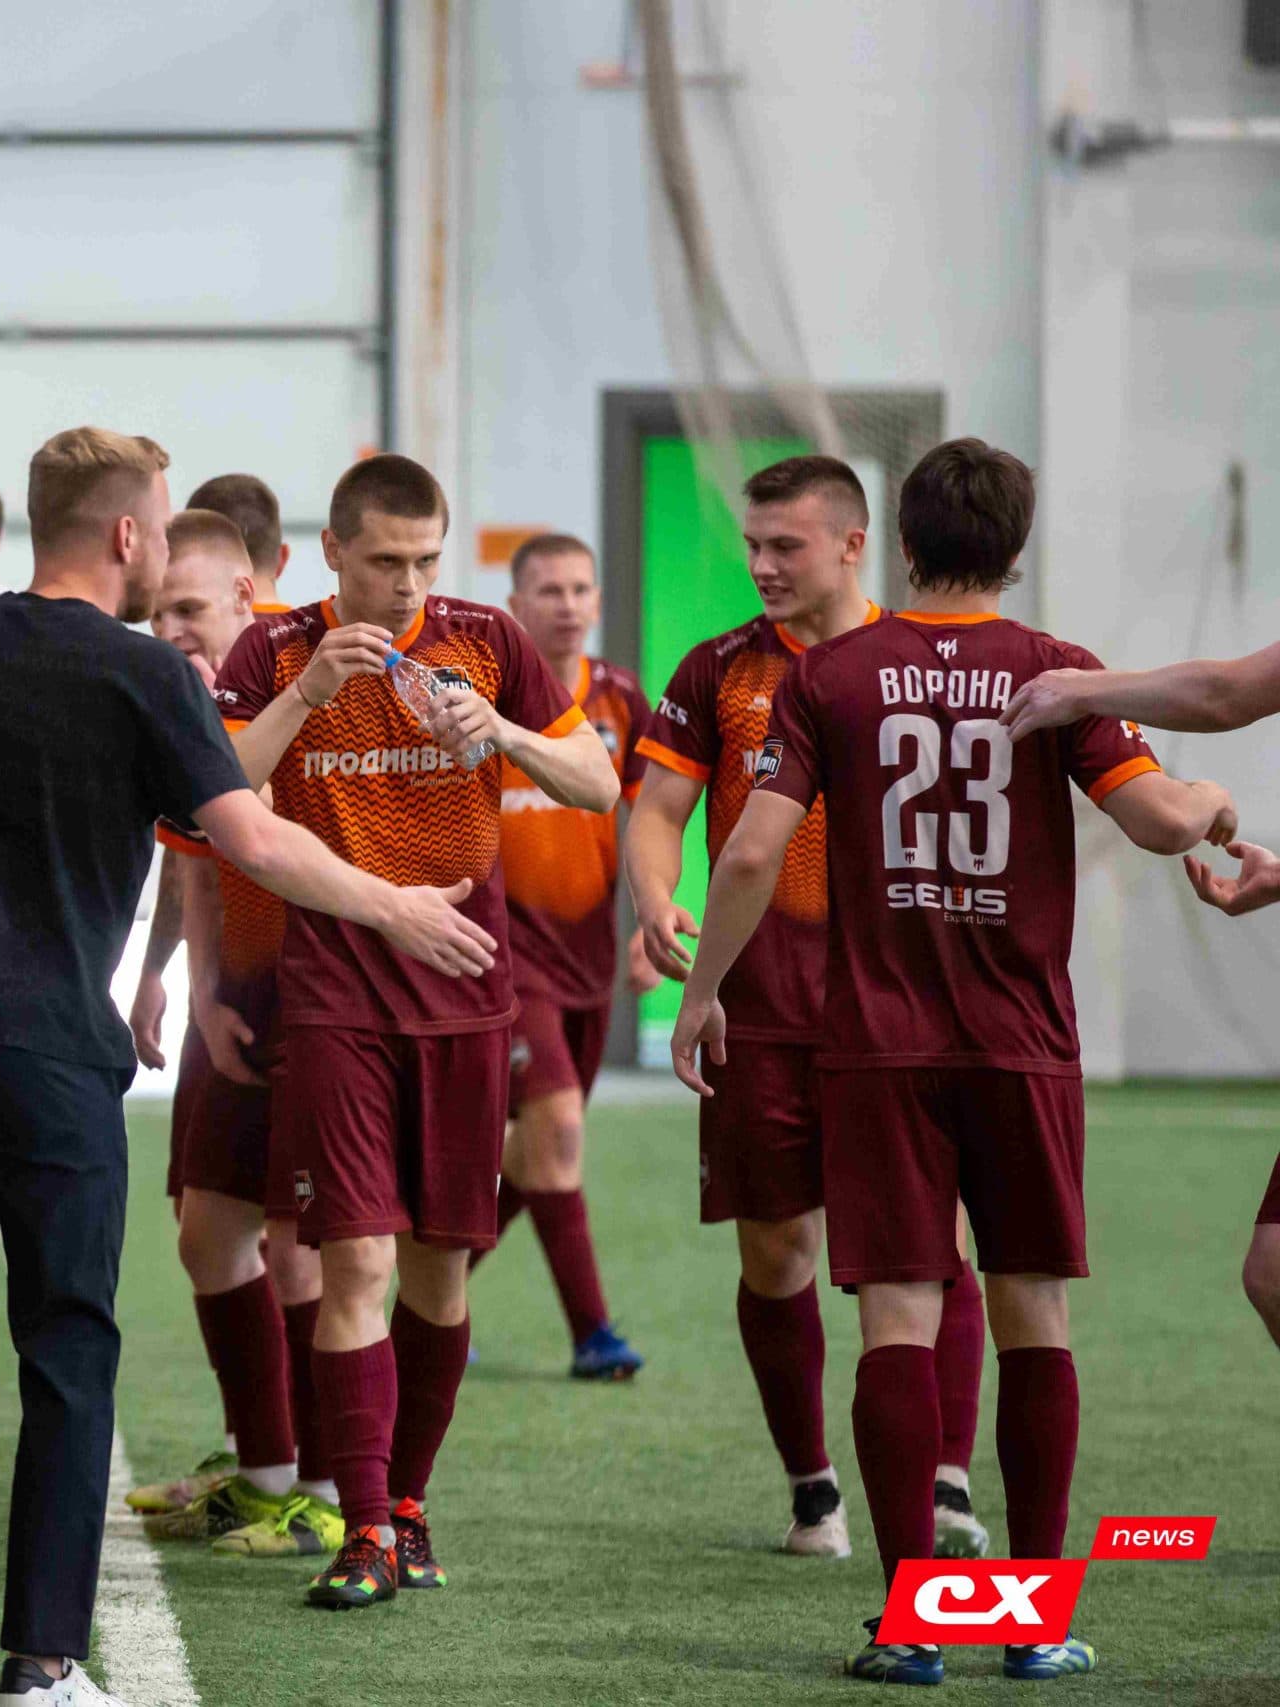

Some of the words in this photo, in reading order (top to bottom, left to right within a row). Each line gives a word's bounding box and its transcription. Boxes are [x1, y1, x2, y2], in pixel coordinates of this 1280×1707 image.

[879, 665, 1012, 710] ВОРОНА
[305, 746, 455, 778] ПРОДИНВЕ
[878, 713, 1012, 876] 23
[887, 883, 1007, 915] SEUS
[976, 914, 1006, 926] Union
